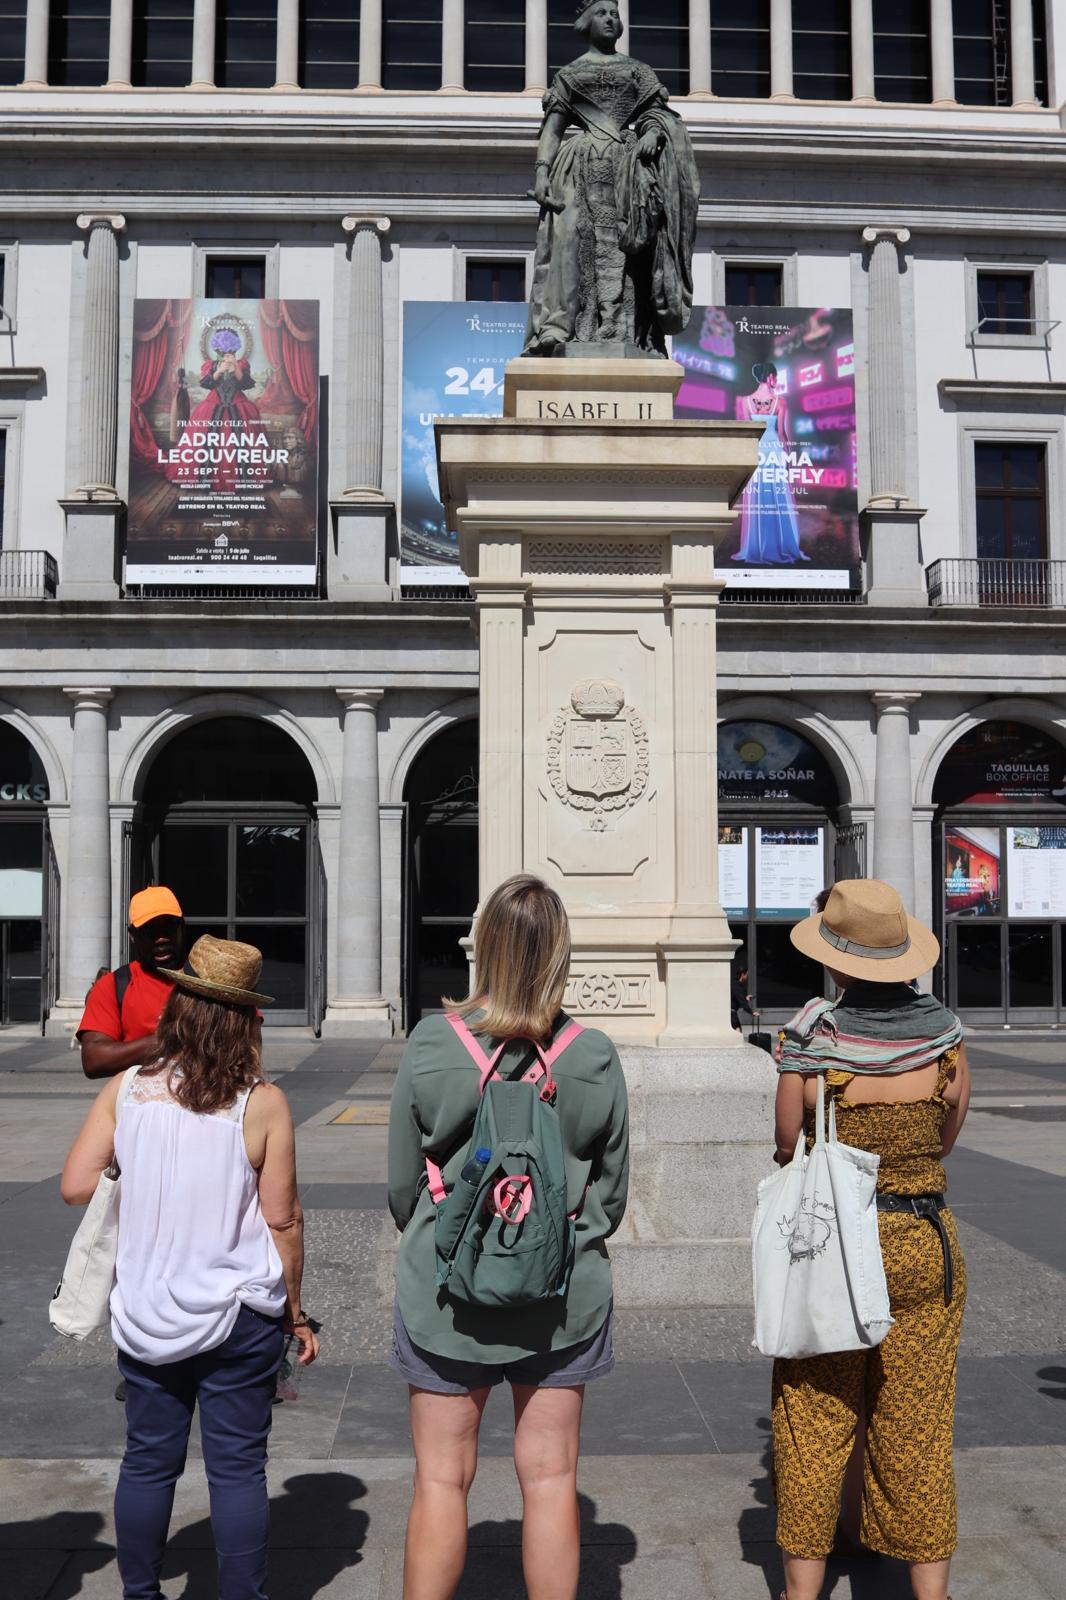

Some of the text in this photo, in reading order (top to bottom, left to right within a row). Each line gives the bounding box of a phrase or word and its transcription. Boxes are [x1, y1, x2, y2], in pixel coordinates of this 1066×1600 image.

[639, 403, 653, 419] II
[176, 420, 224, 428] FRANCESCO
[224, 420, 248, 428] CILEA
[178, 432, 269, 447] ADRIANA
[157, 449, 289, 464] LECOUVREUR
[177, 467, 189, 475] 23
[193, 467, 219, 475] SEPT
[235, 467, 242, 475] 11
[247, 467, 269, 475] OCT
[791, 487, 808, 495] JUL
[991, 764, 1050, 772] TAQUILLAS
[755, 770, 766, 780] A
[768, 767, 815, 780] SOÑAR
[986, 772, 1049, 781] BOX OFFICE
